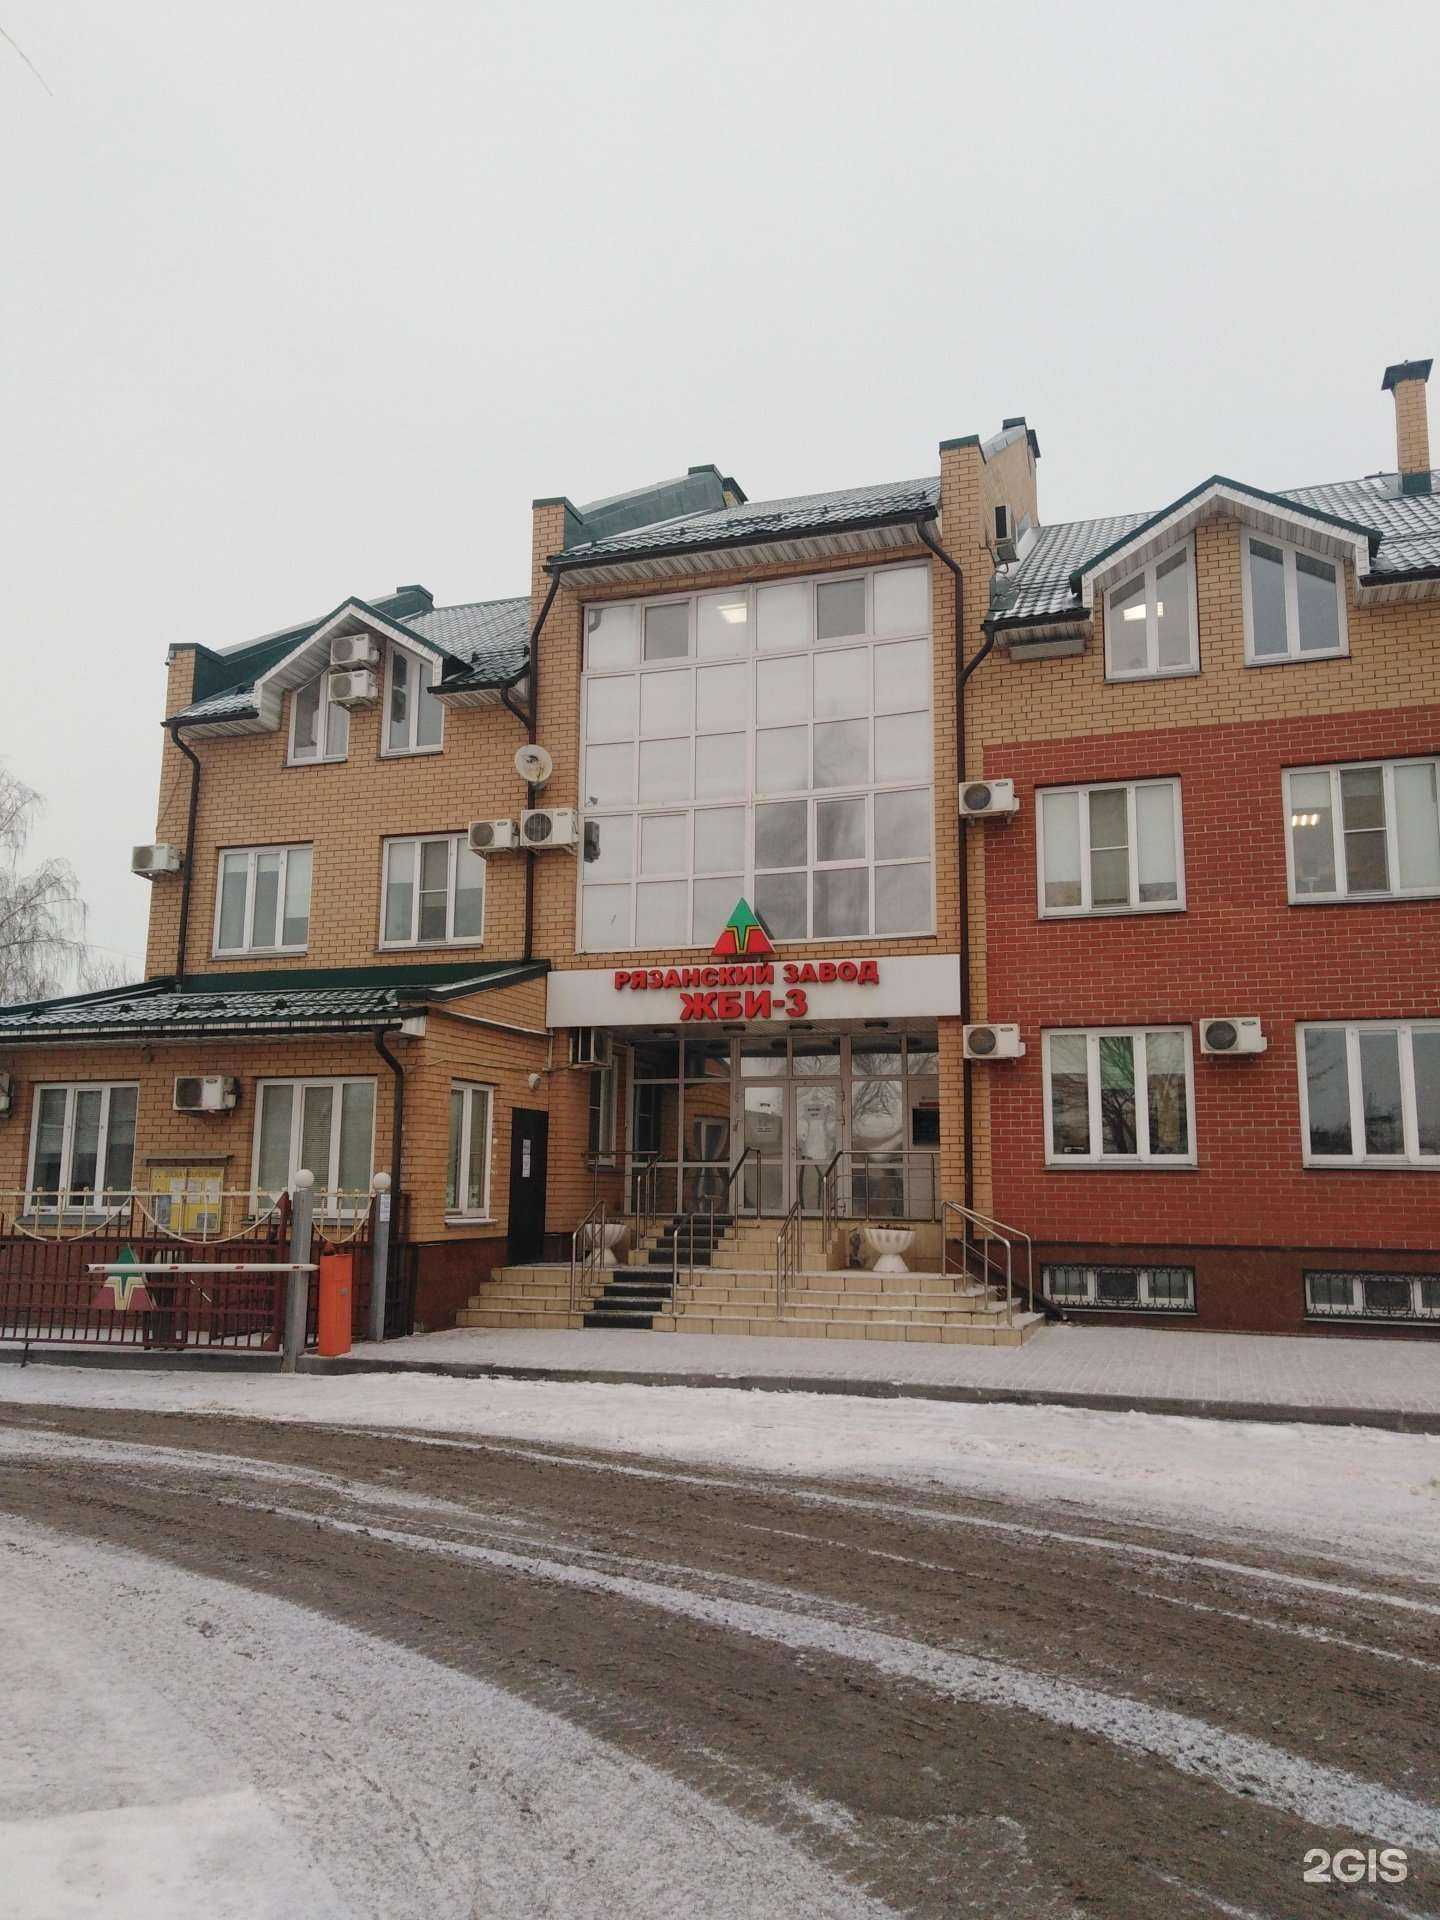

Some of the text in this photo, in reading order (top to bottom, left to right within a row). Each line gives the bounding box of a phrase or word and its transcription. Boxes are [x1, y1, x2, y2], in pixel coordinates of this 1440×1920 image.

[614, 960, 879, 990] РЯЗАНСКИЙ ЗАВОД
[680, 988, 808, 1021] ЖБИ-3
